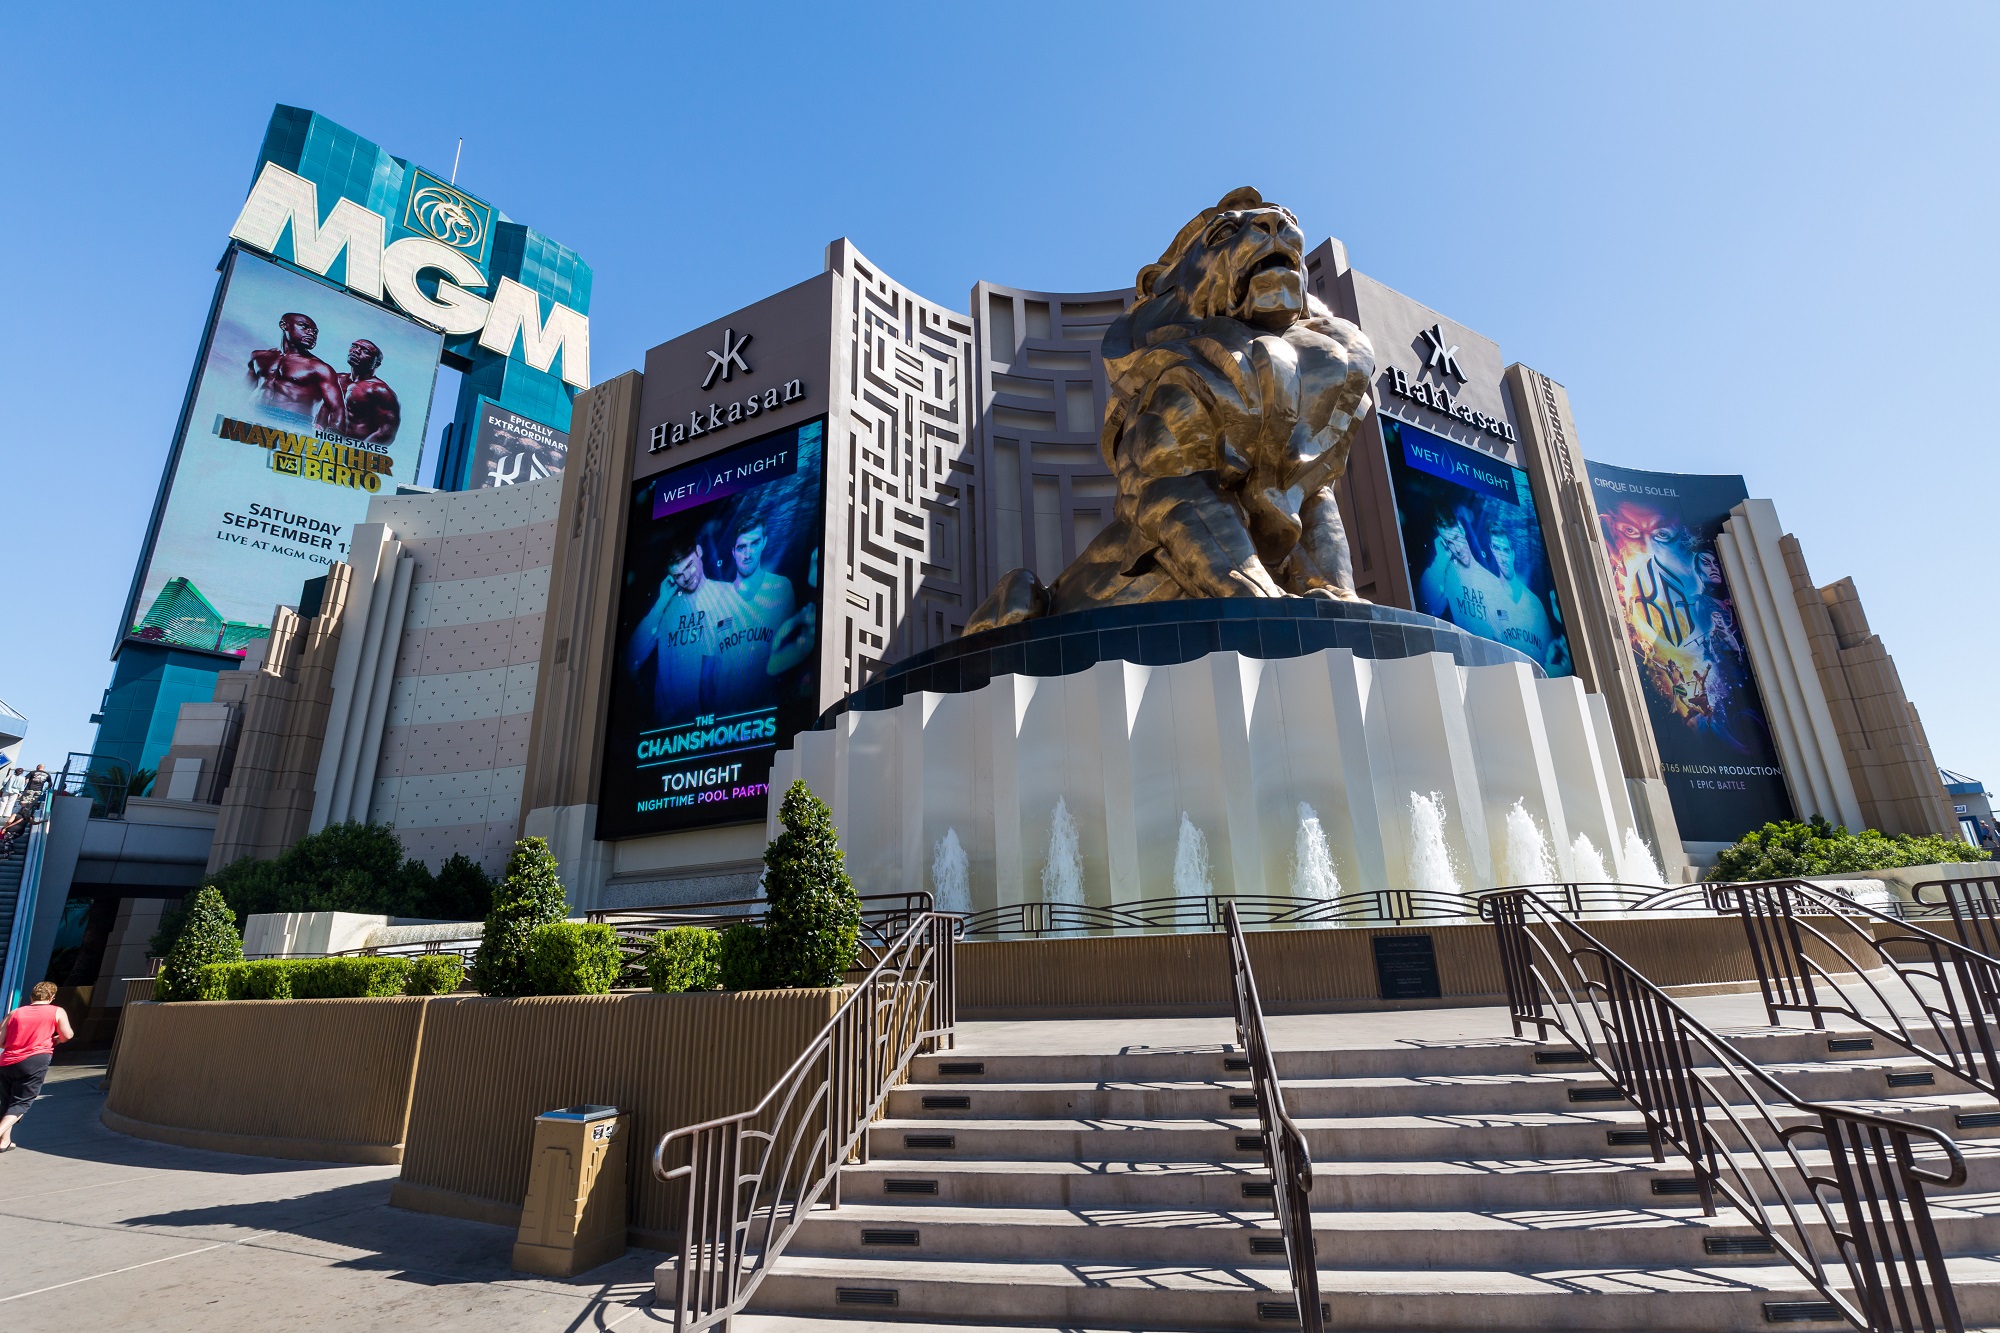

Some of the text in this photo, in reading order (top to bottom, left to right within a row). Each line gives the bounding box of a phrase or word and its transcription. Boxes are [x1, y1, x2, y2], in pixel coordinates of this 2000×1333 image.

[229, 161, 590, 390] MGM
[647, 377, 804, 454] Hakkasan
[1388, 366, 1517, 443] Hakkasan
[315, 430, 388, 454] HIGH STAKES
[489, 416, 568, 453] EXTRAORDINARY
[510, 415, 553, 437] EPICALLY
[219, 417, 393, 476] MAYWEATHER
[278, 457, 382, 493] VS BERTO
[663, 451, 788, 503] WET AT NIGHT
[1410, 444, 1509, 491] WET AT NIGHT
[1594, 477, 1680, 497] CIRQUE DU SOLEIL
[222, 512, 351, 555] SEPTEMBER 1
[249, 503, 342, 537] SATURDAY
[217, 531, 347, 566] LIVE AT MGM GRA
[1462, 585, 1484, 604] RAP
[678, 610, 705, 630] RAP
[719, 626, 774, 654] PROFOUND
[1504, 627, 1542, 650] PROFOUND
[696, 714, 715, 727] THE
[637, 717, 776, 760] CHAINSMOKERS
[662, 763, 742, 792] TONIGHT
[1682, 765, 1717, 774] MILLION
[1719, 766, 1781, 776] PRODUCTION
[1697, 780, 1715, 789] EPIC
[1717, 781, 1746, 790] BATTLE
[637, 783, 770, 813] NIGHTTIME POOL PARTY
